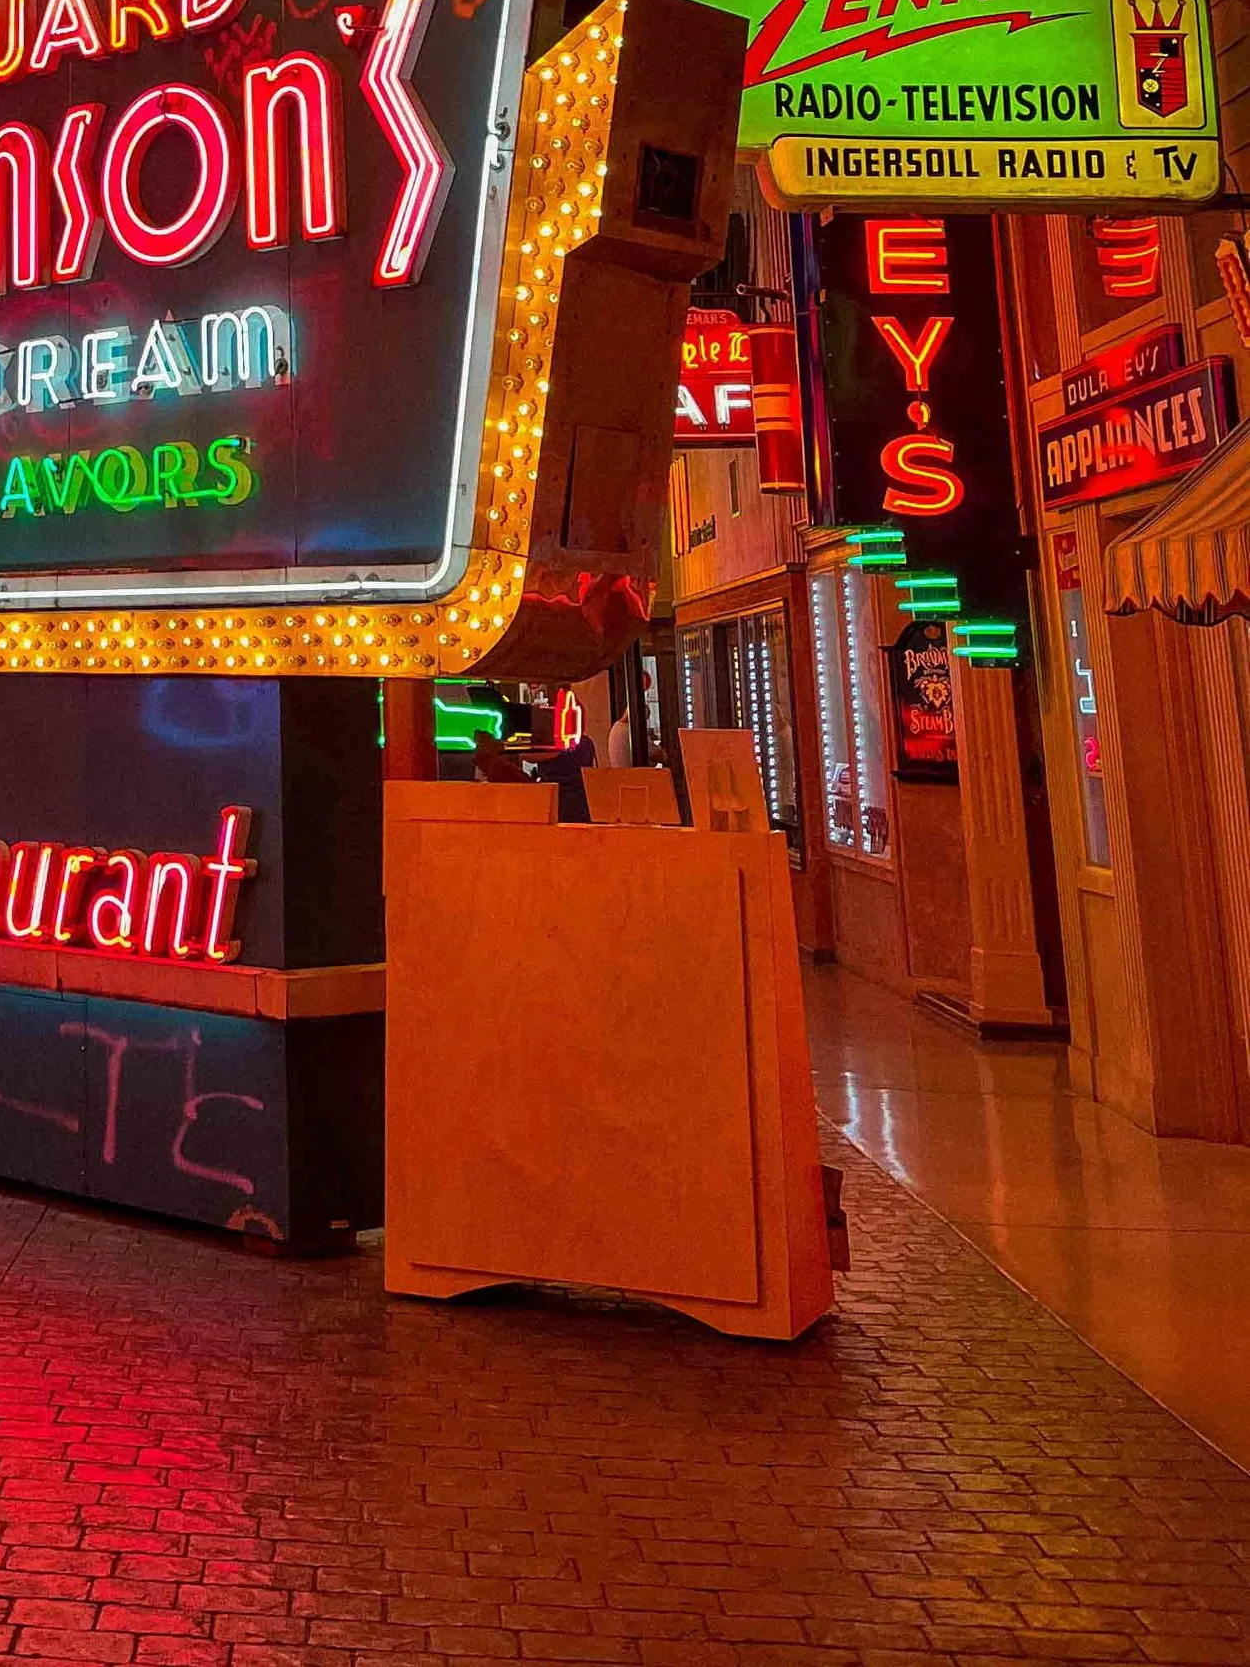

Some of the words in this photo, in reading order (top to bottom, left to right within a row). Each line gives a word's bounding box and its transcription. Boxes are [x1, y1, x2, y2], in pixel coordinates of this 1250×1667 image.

[805, 146, 981, 180] INGERSOLL
[997, 148, 1106, 180] RADIO
[1125, 150, 1137, 180] &
[1153, 144, 1199, 182] TV
[682, 334, 720, 368] ple
[1067, 345, 1159, 406] DULAEY'S
[674, 383, 752, 426] AF
[1046, 386, 1207, 488] APPLIANCES
